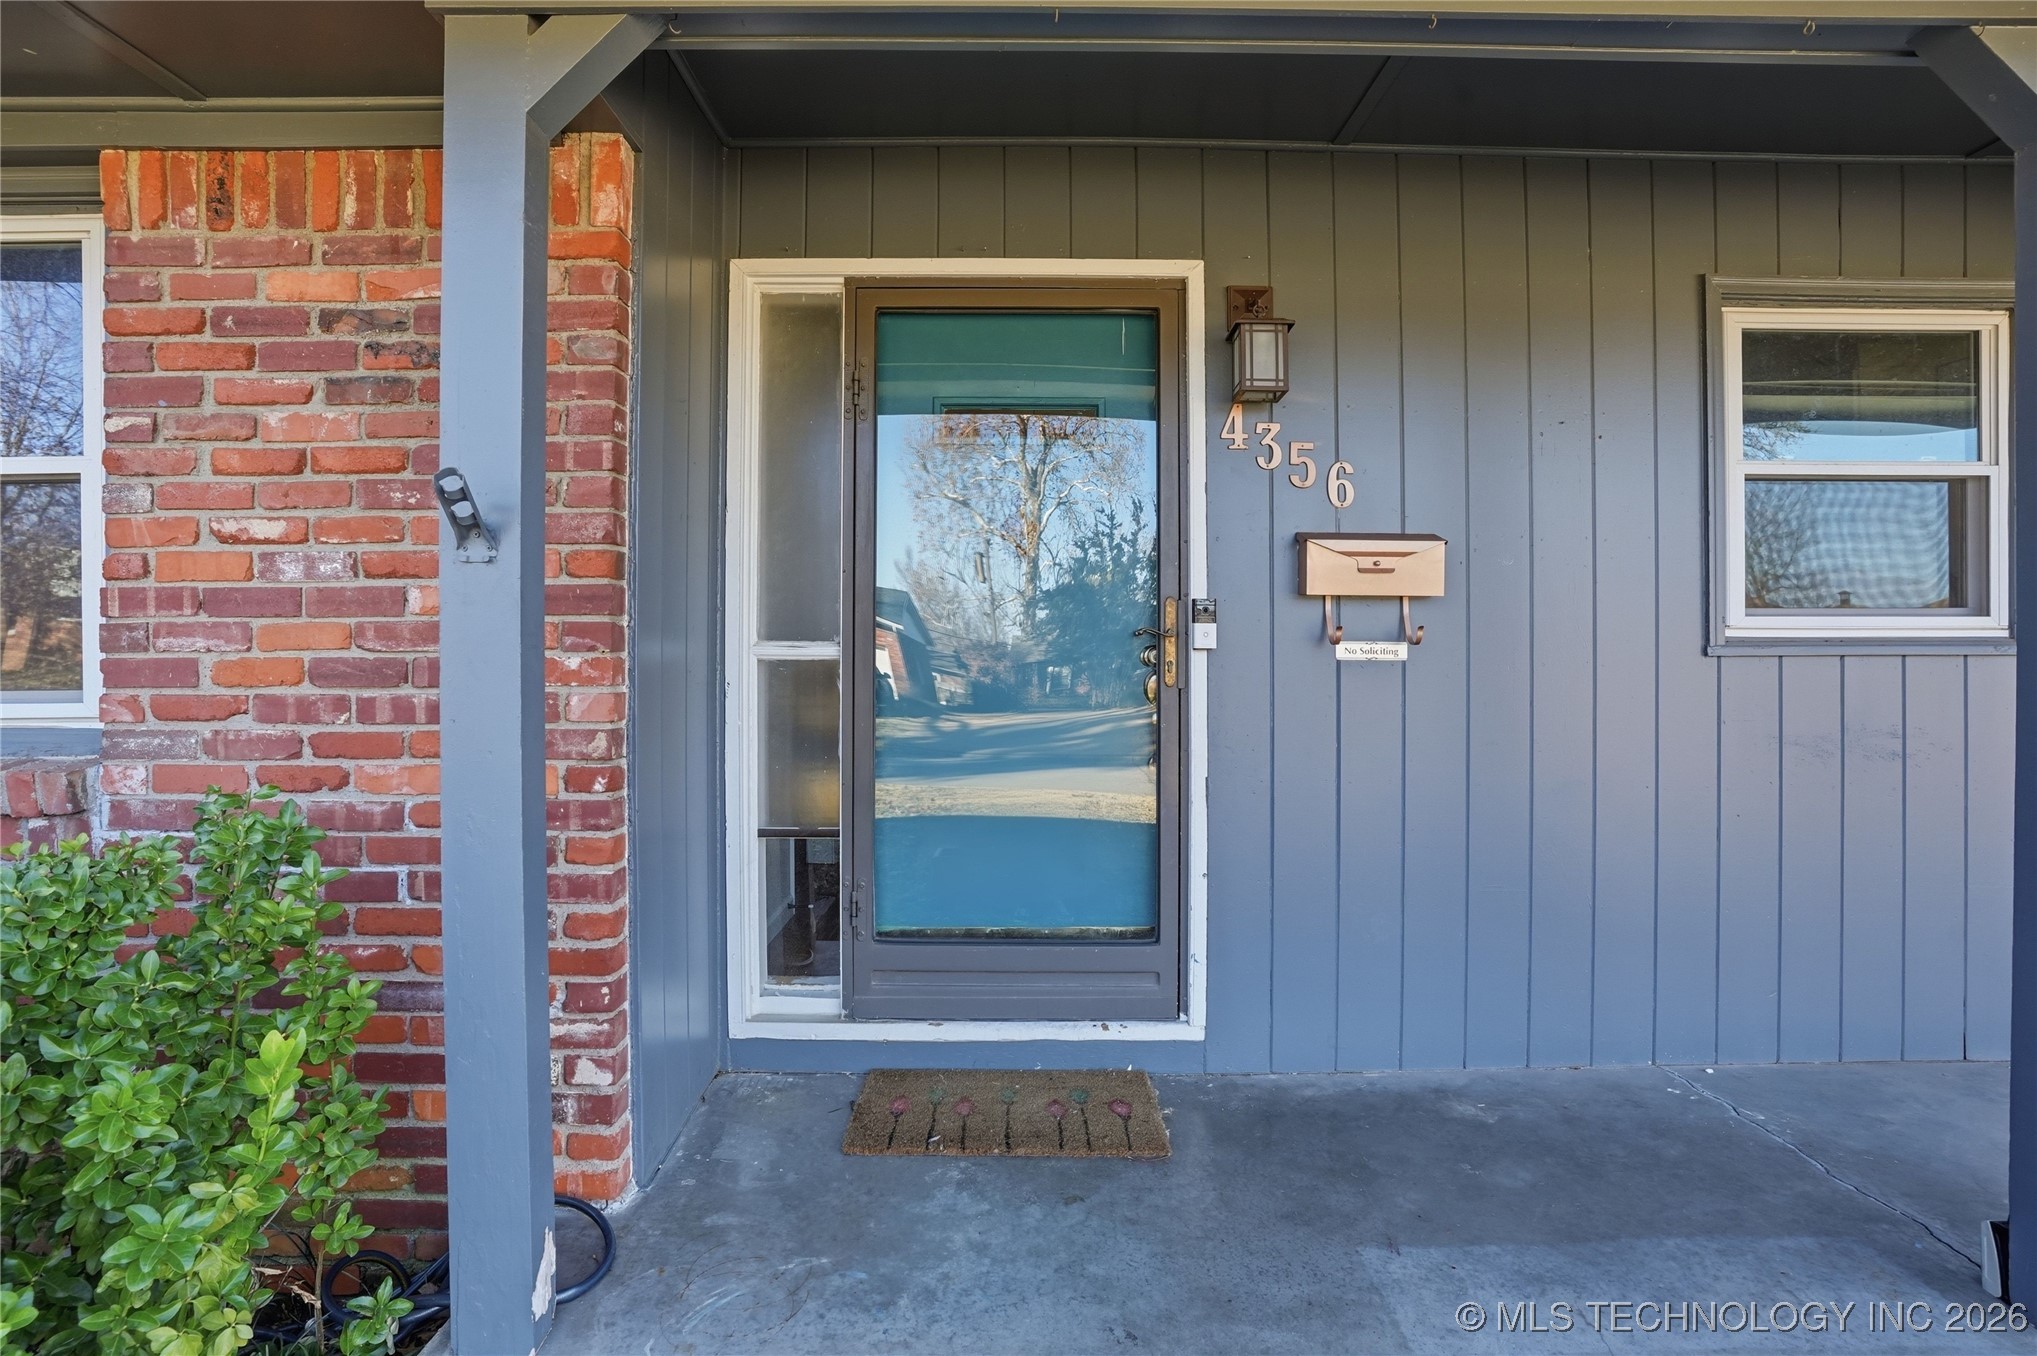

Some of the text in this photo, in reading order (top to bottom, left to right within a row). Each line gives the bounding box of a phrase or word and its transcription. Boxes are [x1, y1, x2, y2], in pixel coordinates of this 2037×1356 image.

[1220, 403, 1355, 508] 4356
[1344, 646, 1399, 657] No Soliciting
